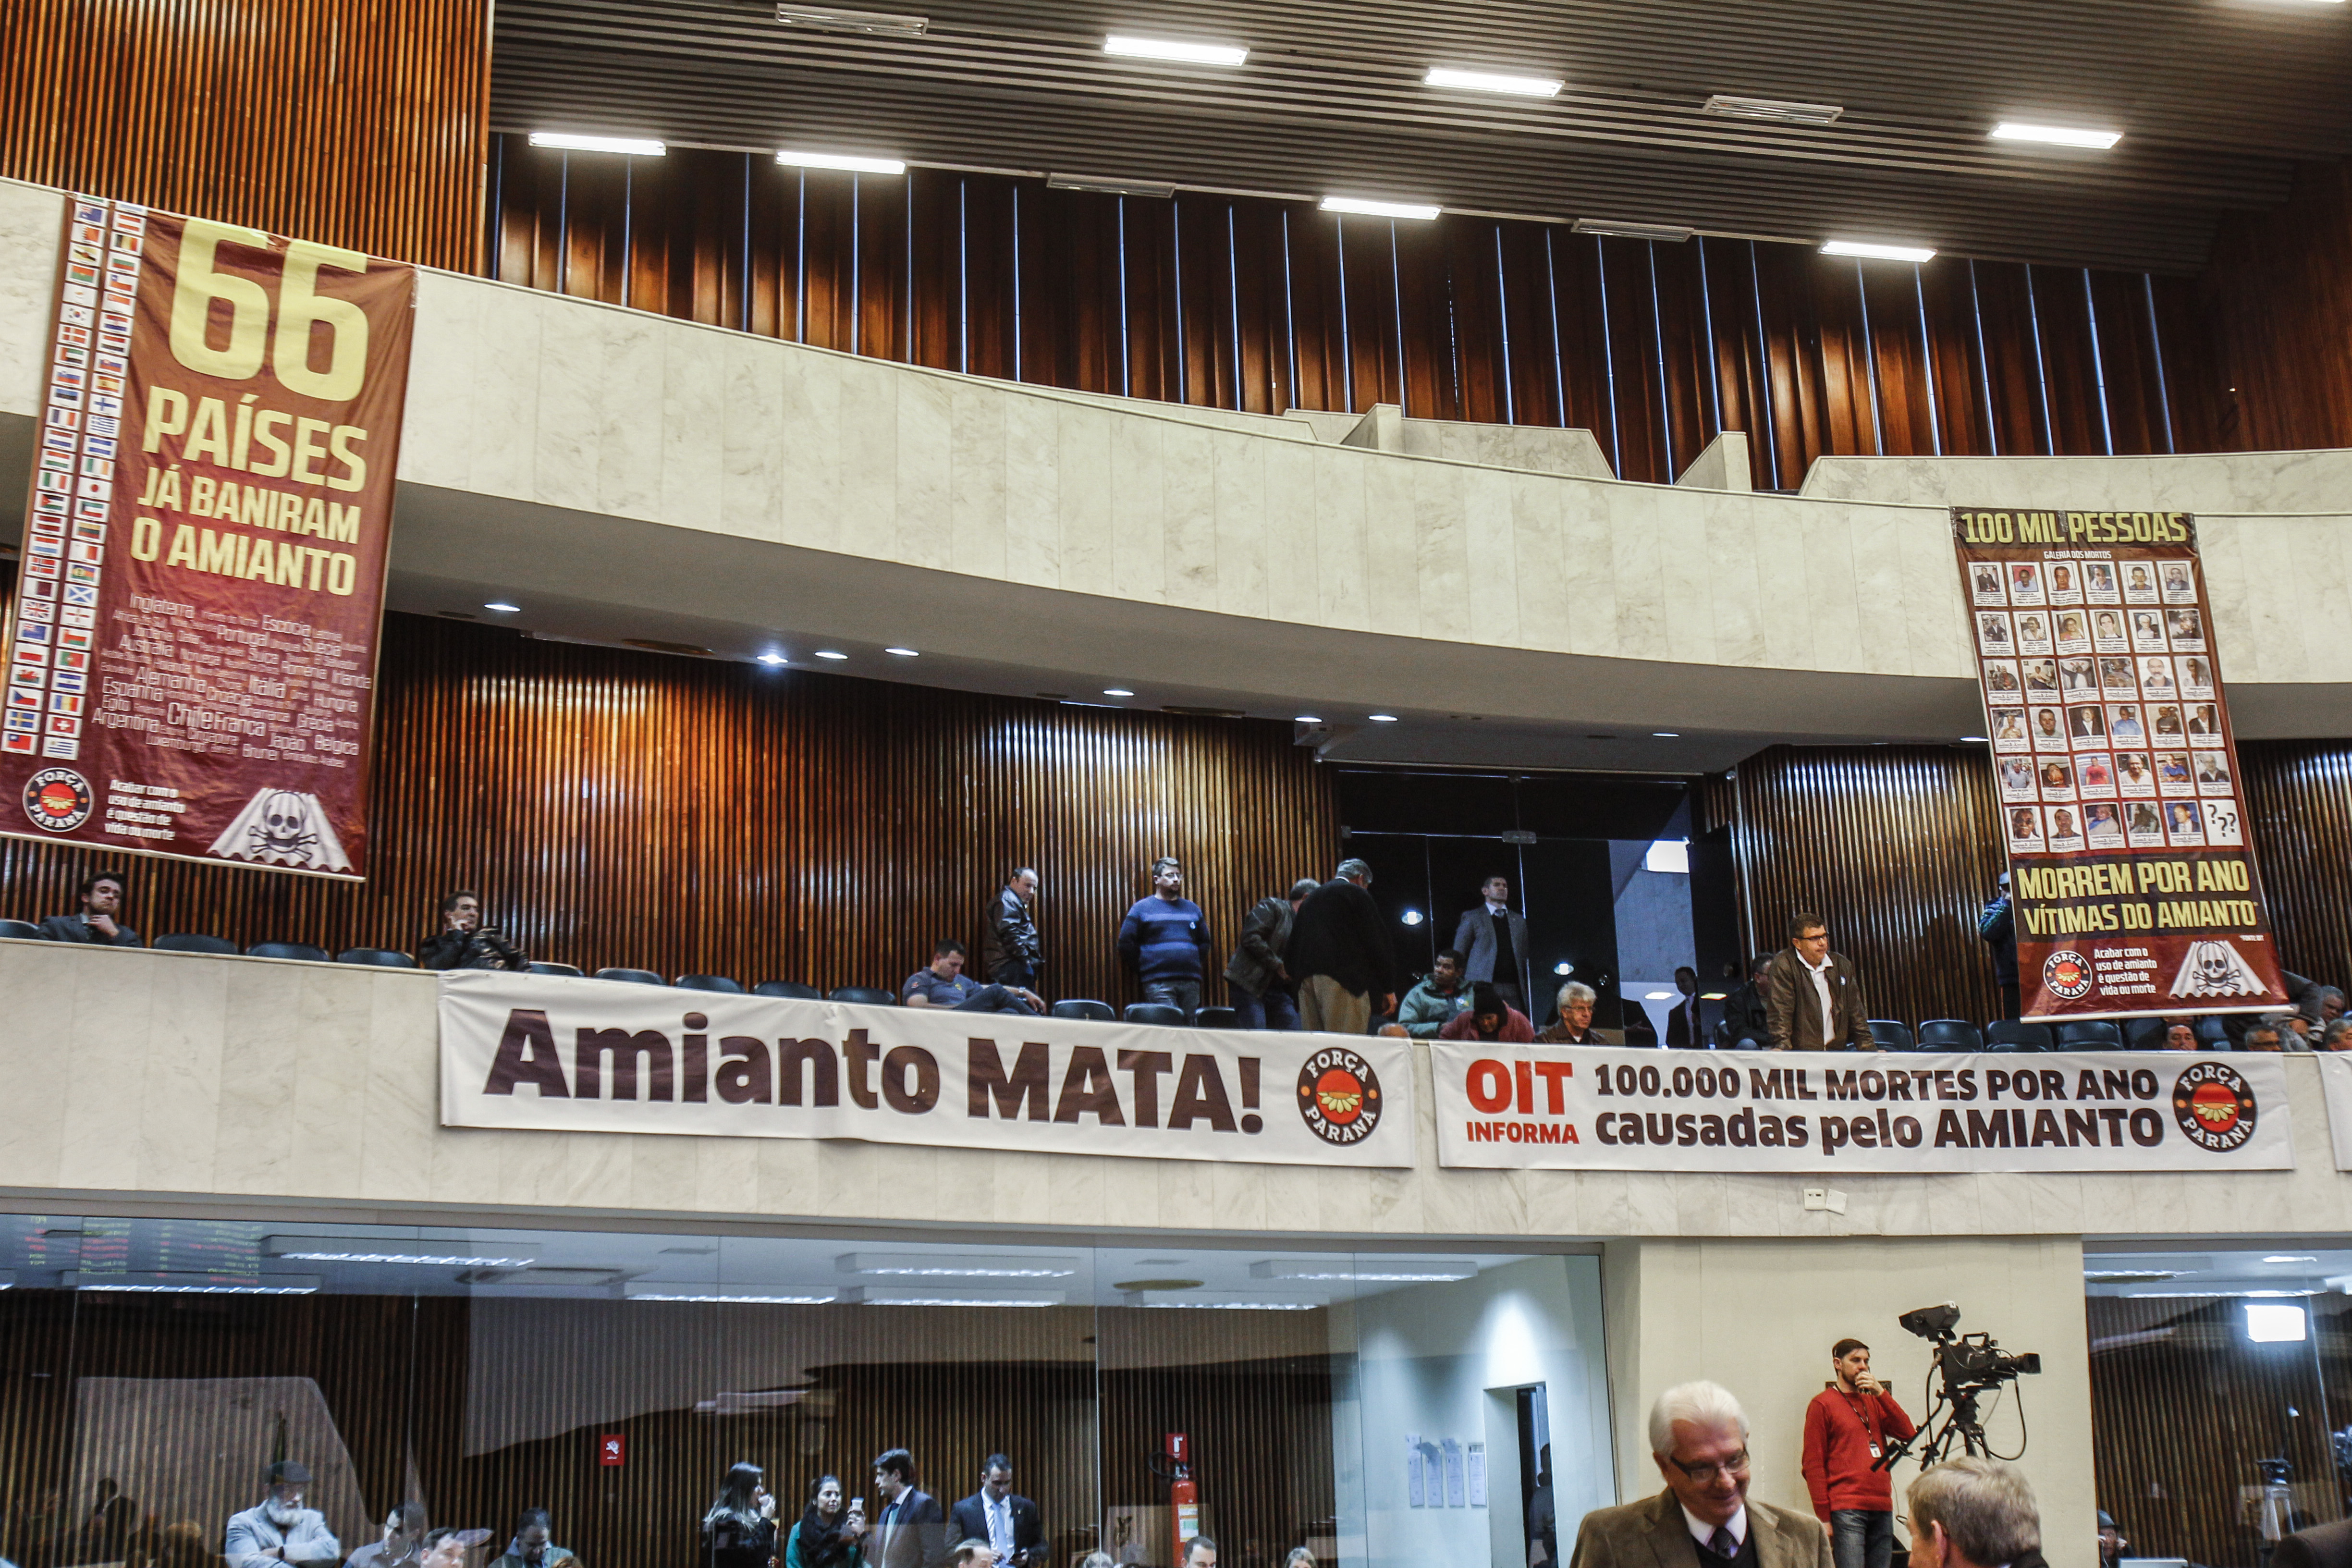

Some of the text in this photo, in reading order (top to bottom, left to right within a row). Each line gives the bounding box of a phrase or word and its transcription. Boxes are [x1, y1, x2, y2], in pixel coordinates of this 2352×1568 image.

[169, 217, 369, 402] 66
[142, 385, 368, 492] PAÍSES
[137, 464, 361, 544] JÁ BANIRAM
[1961, 512, 2187, 543] 100 MIL PESSOAS
[130, 516, 356, 596] O AMIANTO
[2044, 550, 2112, 559] GALERIA DOS MORTOS
[130, 592, 196, 619] Inglaterra
[217, 624, 270, 648] Portugal
[262, 614, 312, 637] Escócia
[119, 635, 174, 657] Austrália
[303, 637, 342, 657] Suécia
[102, 676, 164, 701] Espanha
[135, 666, 207, 693] Alemanha
[248, 674, 286, 698] Itália
[332, 670, 372, 689] Irlanda
[92, 708, 161, 733] Argentina
[167, 702, 214, 729] Chile
[214, 711, 266, 737] França
[314, 735, 359, 755] Bélgica
[35, 771, 85, 792] FORÇA
[29, 804, 86, 828] PARANÁ
[2017, 860, 2250, 900] MORREM POR ANO
[2023, 904, 2119, 935] VÍTIMAS
[2121, 903, 2153, 930] DO
[2048, 953, 2083, 968] FORÇA
[2094, 947, 2149, 959] Acabar com o
[2095, 958, 2158, 971] uso de amianto
[2050, 979, 2089, 995] PARANÁ
[2097, 971, 2150, 985] é questão de
[2099, 983, 2156, 996] vida ou morte
[482, 1008, 1264, 1136] Amianto MATA!
[1306, 1051, 1369, 1083] FORÇA
[2180, 1065, 2242, 1092] FORÇA
[1466, 1058, 1573, 1115] OIT
[1594, 1063, 2160, 1102] 100.000 MIL MORTES POR ANO
[1305, 1105, 1377, 1142] PARANÁ
[1466, 1121, 1580, 1145] INFORMA
[1595, 1106, 2165, 1157] causadas pelo AMIANTO
[2182, 1117, 2253, 1149] PARANÁ
